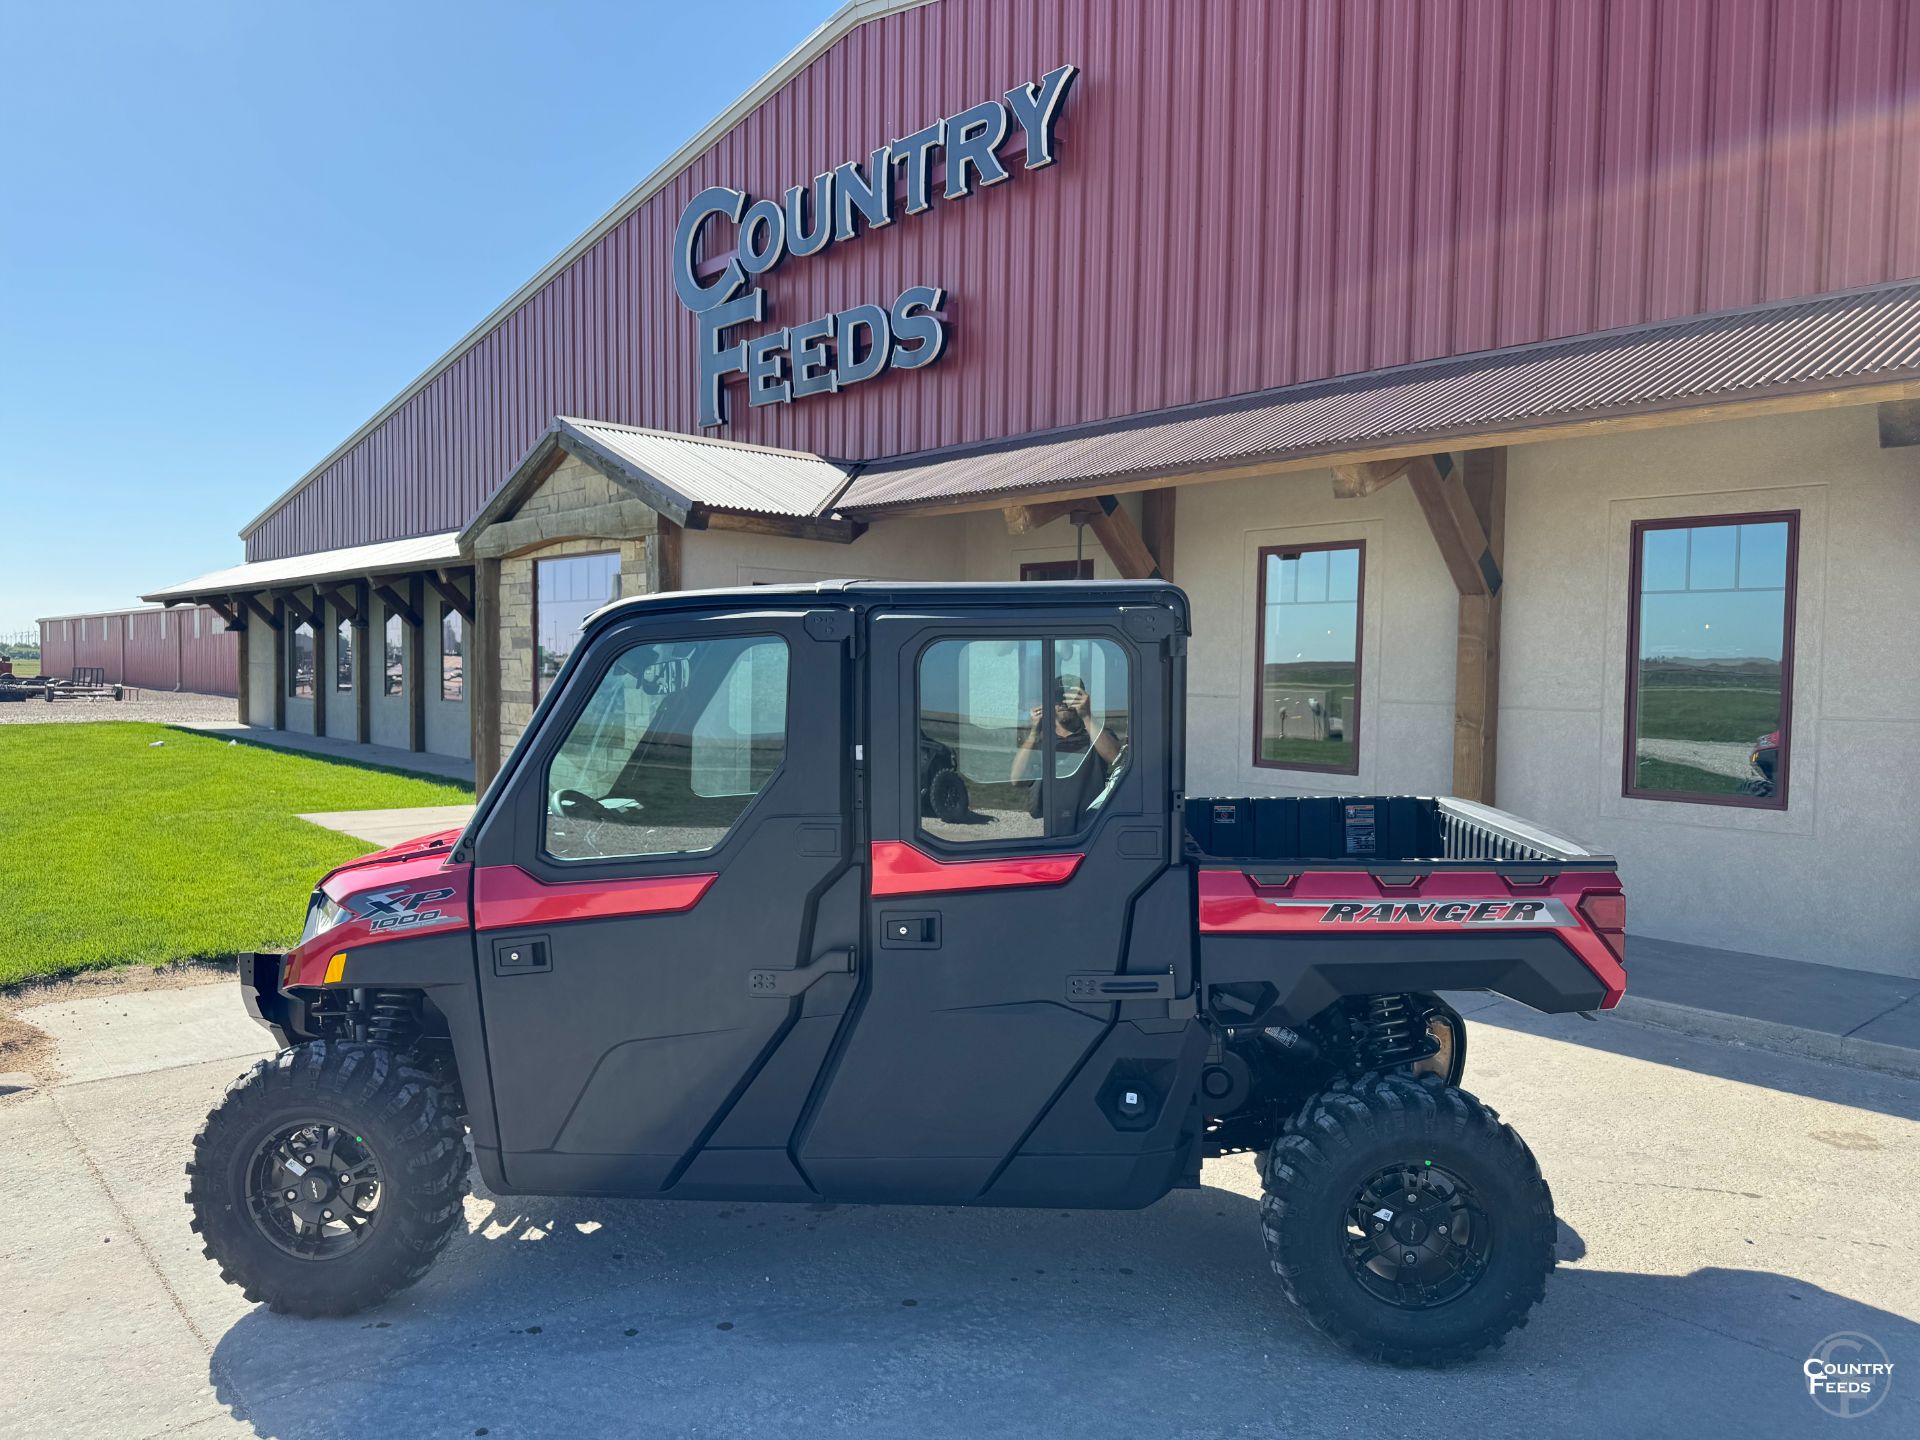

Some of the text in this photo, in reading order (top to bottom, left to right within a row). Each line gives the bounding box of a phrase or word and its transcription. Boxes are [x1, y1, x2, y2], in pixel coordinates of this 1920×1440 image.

[673, 64, 1080, 312] COUNTRY
[697, 286, 948, 428] FEEDS
[351, 887, 456, 922] XP
[369, 909, 441, 931] 1000
[1319, 901, 1546, 923] RANGER
